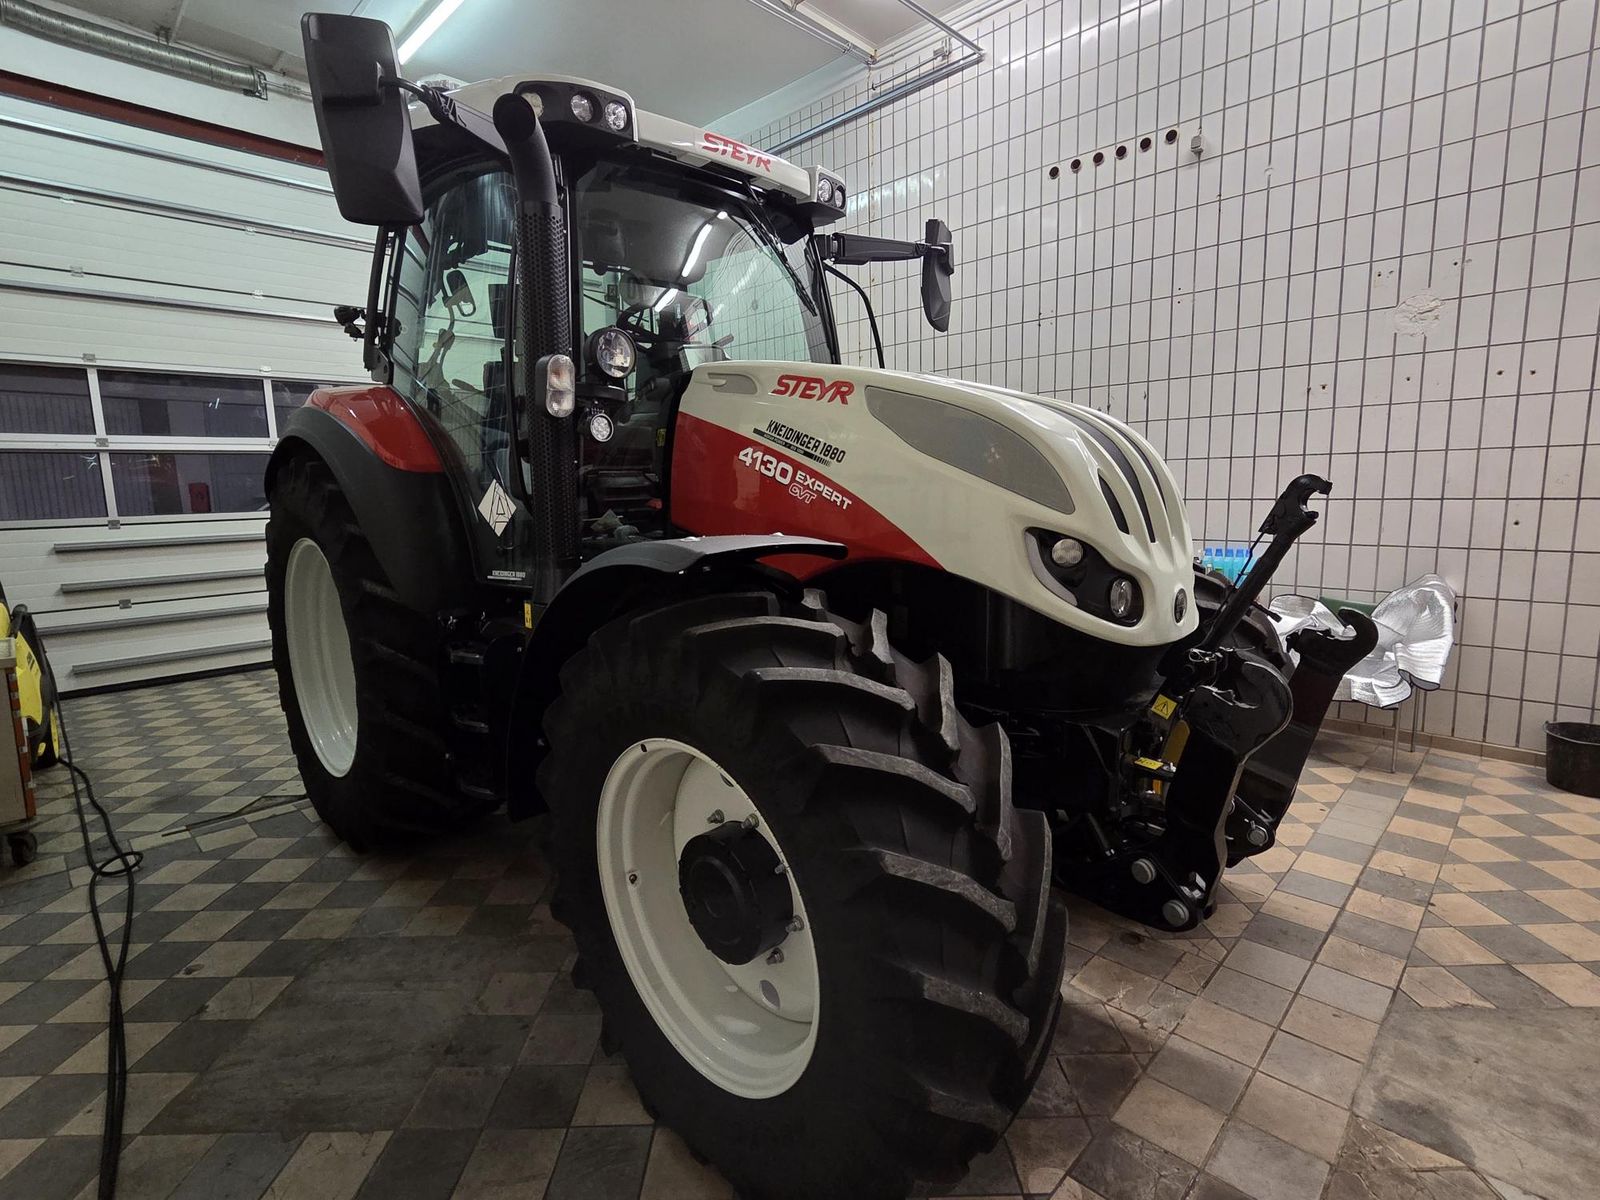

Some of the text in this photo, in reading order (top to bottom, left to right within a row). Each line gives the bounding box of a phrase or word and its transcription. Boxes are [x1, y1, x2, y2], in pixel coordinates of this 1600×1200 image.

[702, 132, 771, 173] STEYR
[770, 374, 855, 406] STEYR
[765, 419, 821, 454] KNEIDINGER
[820, 441, 846, 464] 1880
[738, 446, 852, 510] 4130 EXPERT
